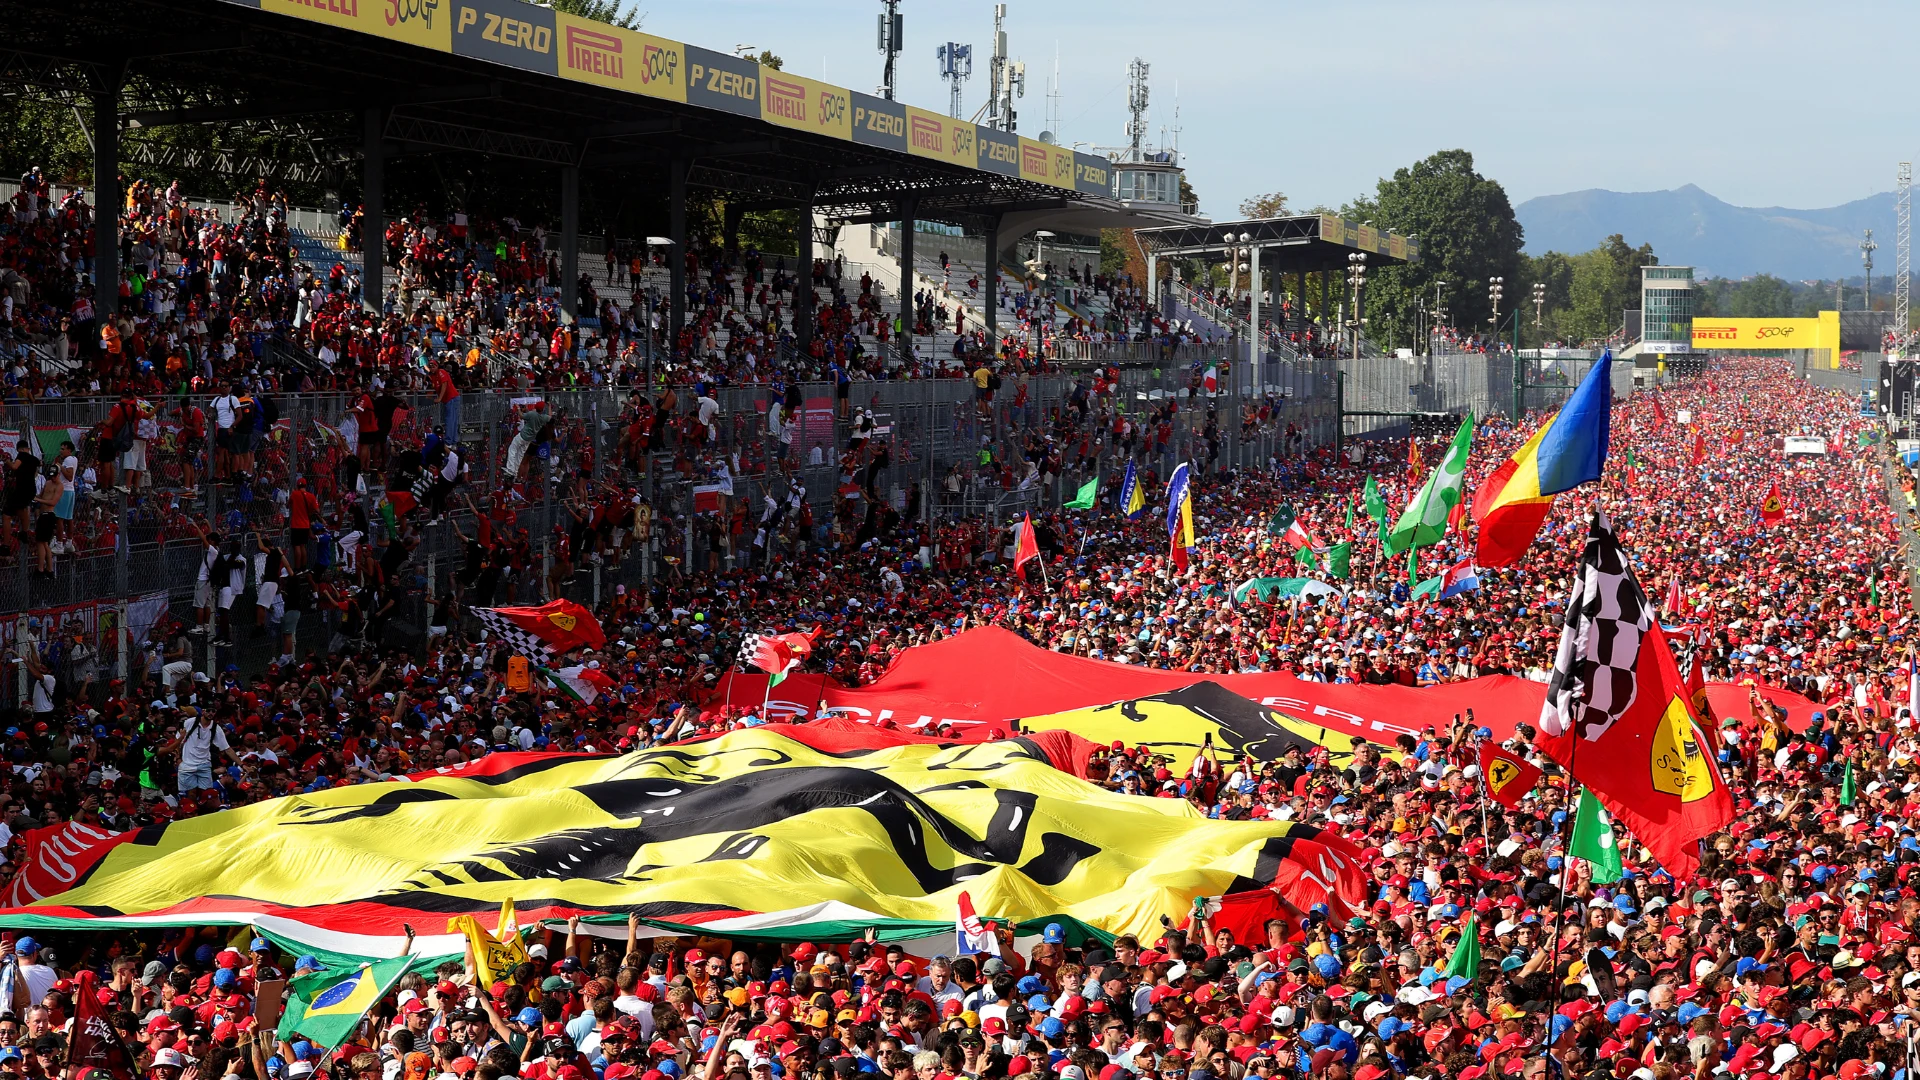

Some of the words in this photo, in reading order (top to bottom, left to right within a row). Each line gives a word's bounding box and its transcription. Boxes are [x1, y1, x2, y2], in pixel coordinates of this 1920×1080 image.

[457, 6, 478, 34] P
[481, 12, 552, 54] ZERO
[565, 24, 623, 80] PIRELLI
[690, 63, 704, 87] P
[707, 67, 756, 101] ZERO
[765, 76, 806, 121] PIRELLI
[854, 107, 865, 127] P
[867, 110, 904, 137] ZERO
[911, 115, 943, 153] PIRELLI
[979, 139, 987, 157] P
[988, 141, 1018, 164] ZERO
[1023, 144, 1048, 177] PIRELLI
[1076, 164, 1083, 179] P
[1084, 165, 1107, 186] ZERO
